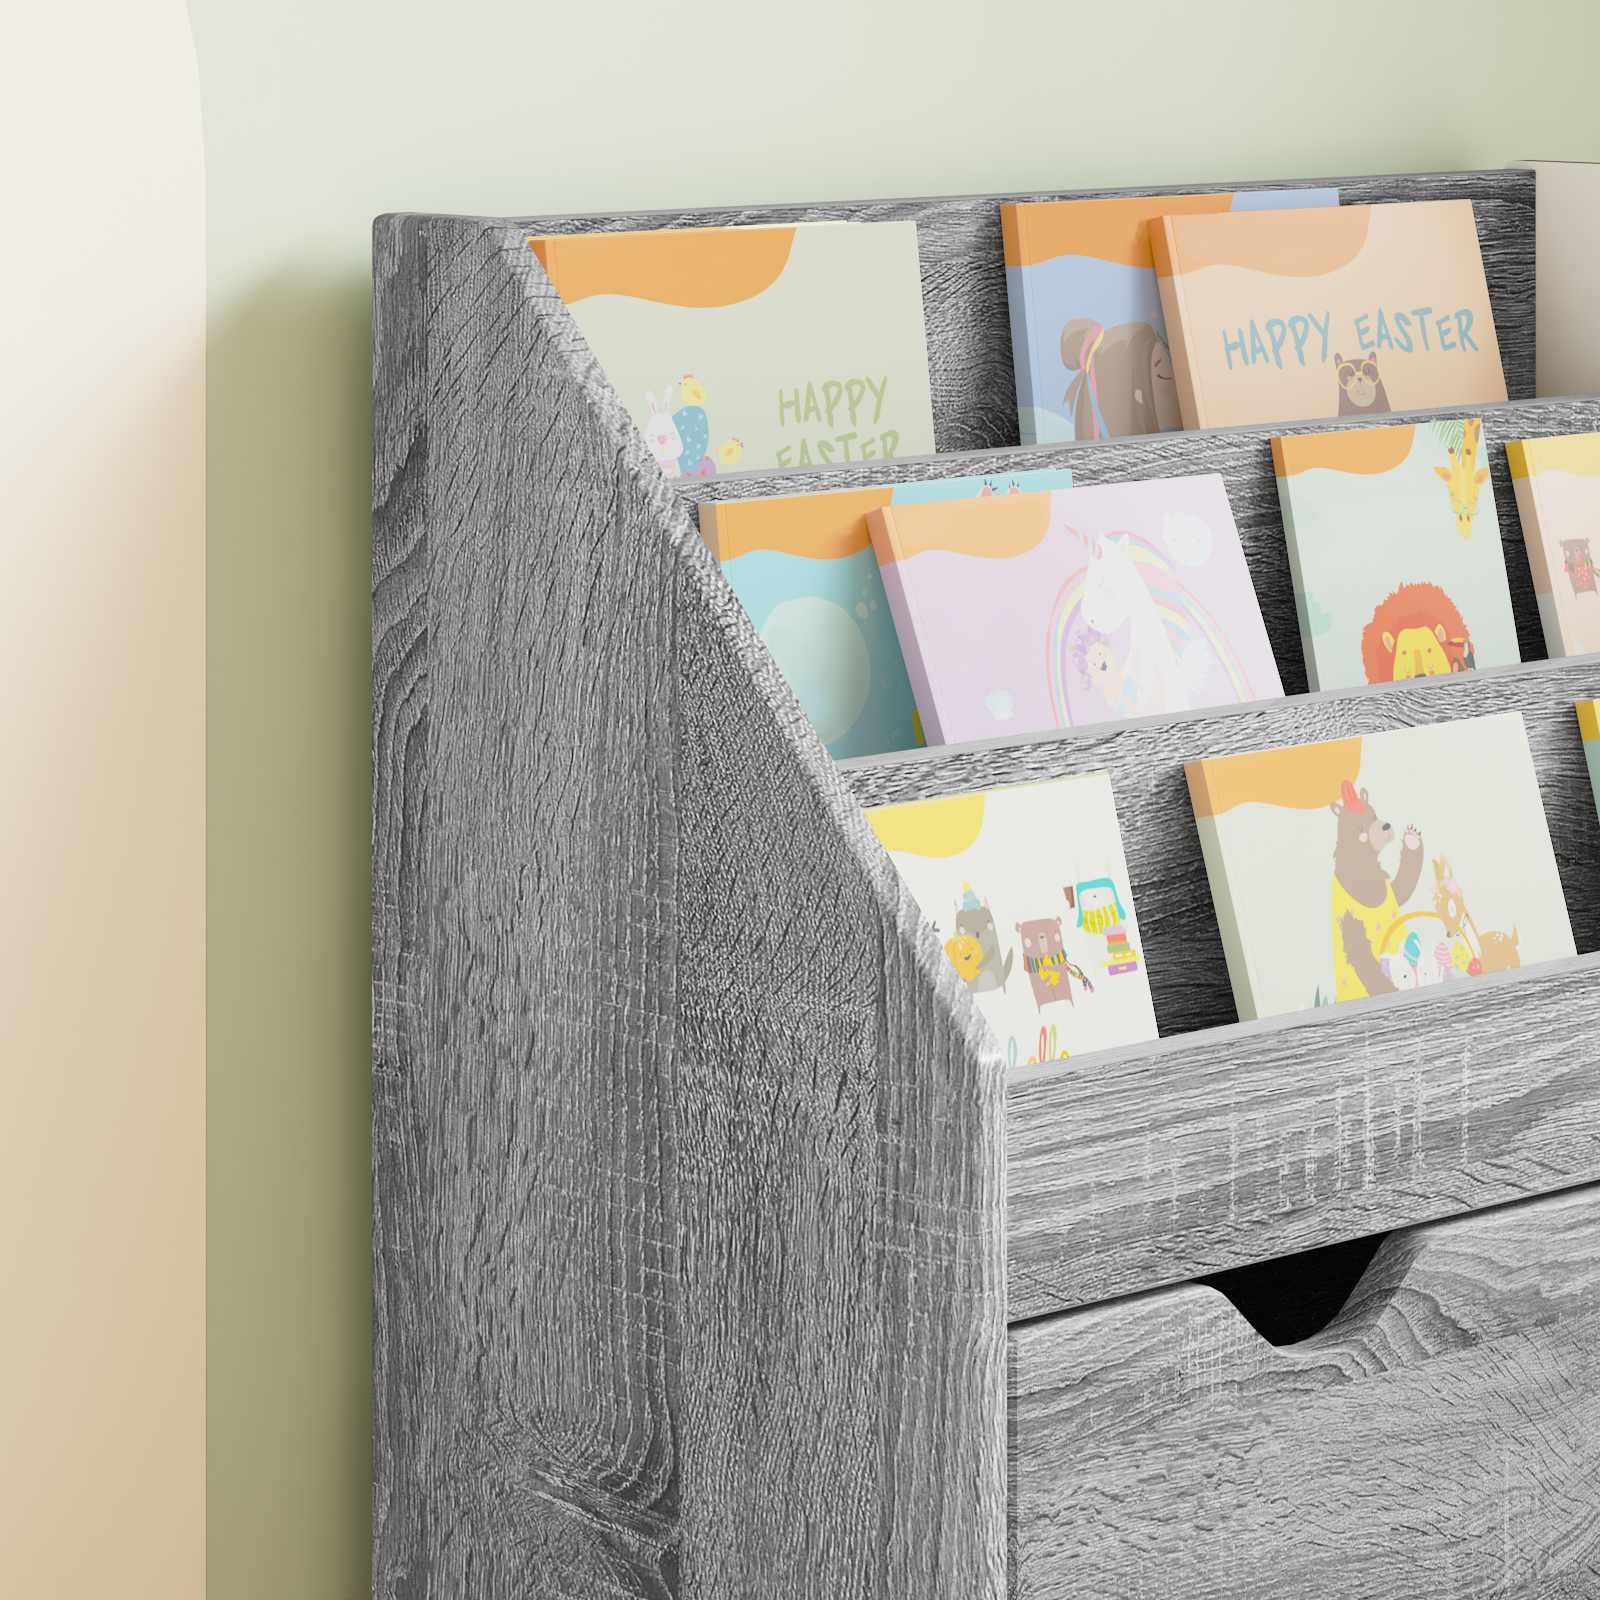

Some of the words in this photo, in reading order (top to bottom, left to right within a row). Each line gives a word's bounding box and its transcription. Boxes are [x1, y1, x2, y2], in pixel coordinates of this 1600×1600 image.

[1222, 312, 1330, 370] HAPPY
[1353, 305, 1479, 353] EASTER
[777, 376, 888, 429] HAPPY
